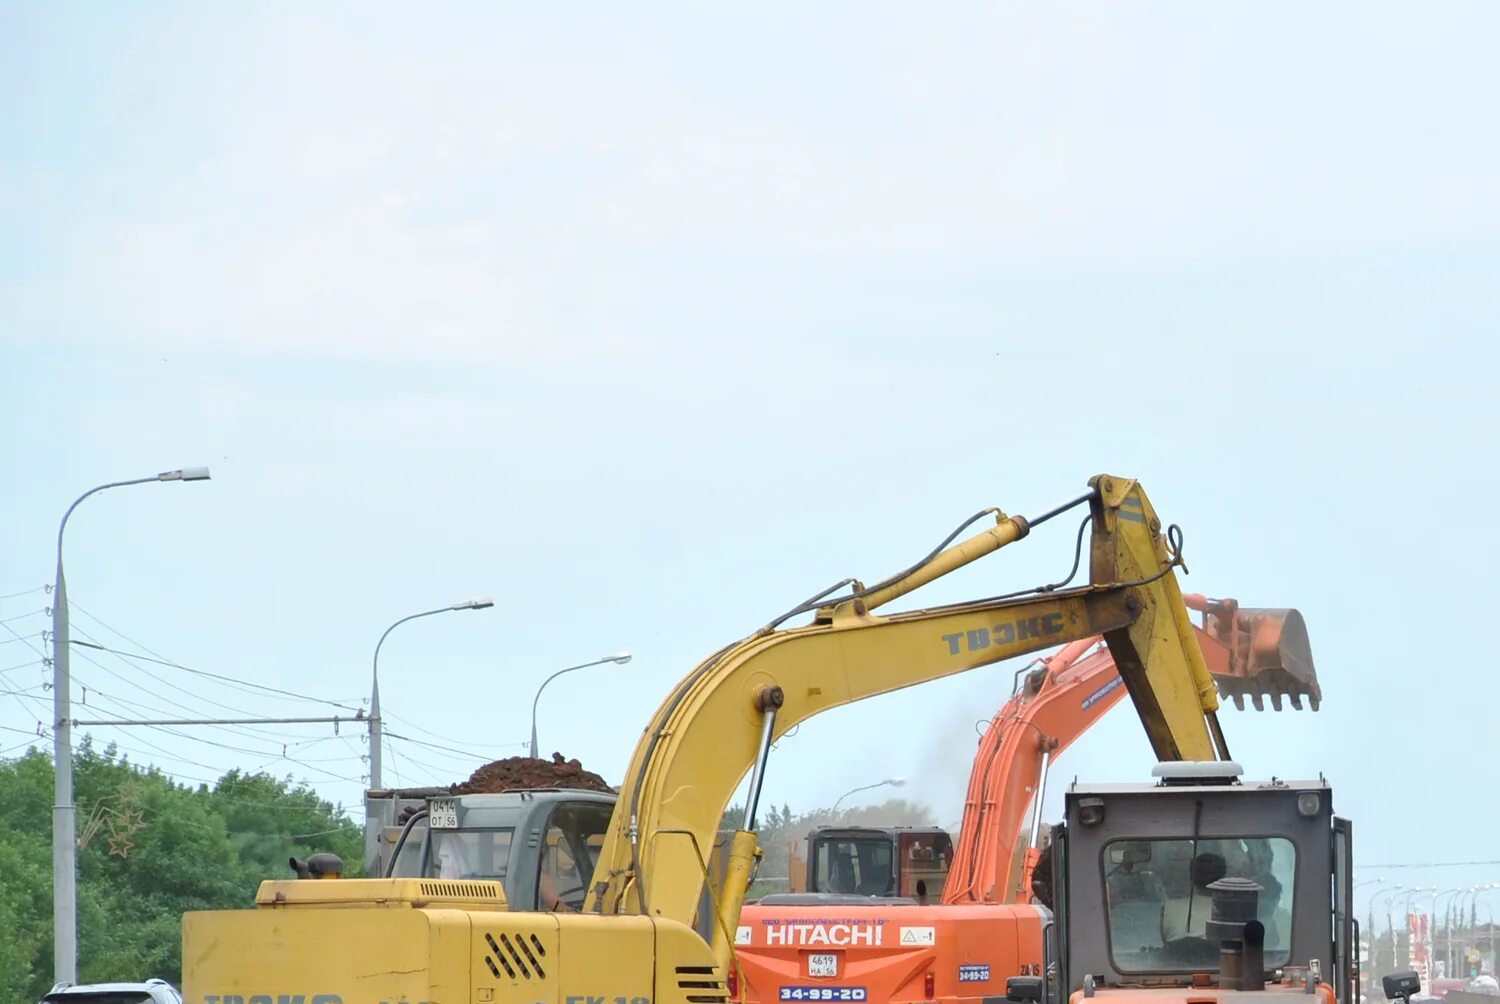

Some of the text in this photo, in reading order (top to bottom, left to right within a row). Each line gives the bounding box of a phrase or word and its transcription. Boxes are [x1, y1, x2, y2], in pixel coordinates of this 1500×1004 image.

[942, 612, 1064, 656] ТВЭКС
[433, 801, 454, 812] 0414
[432, 816, 455, 826] ОТ 56
[767, 925, 882, 945] HITACHI
[812, 956, 833, 965] 4619
[960, 971, 988, 980] 34-99-20
[781, 988, 864, 999] 34-99-20
